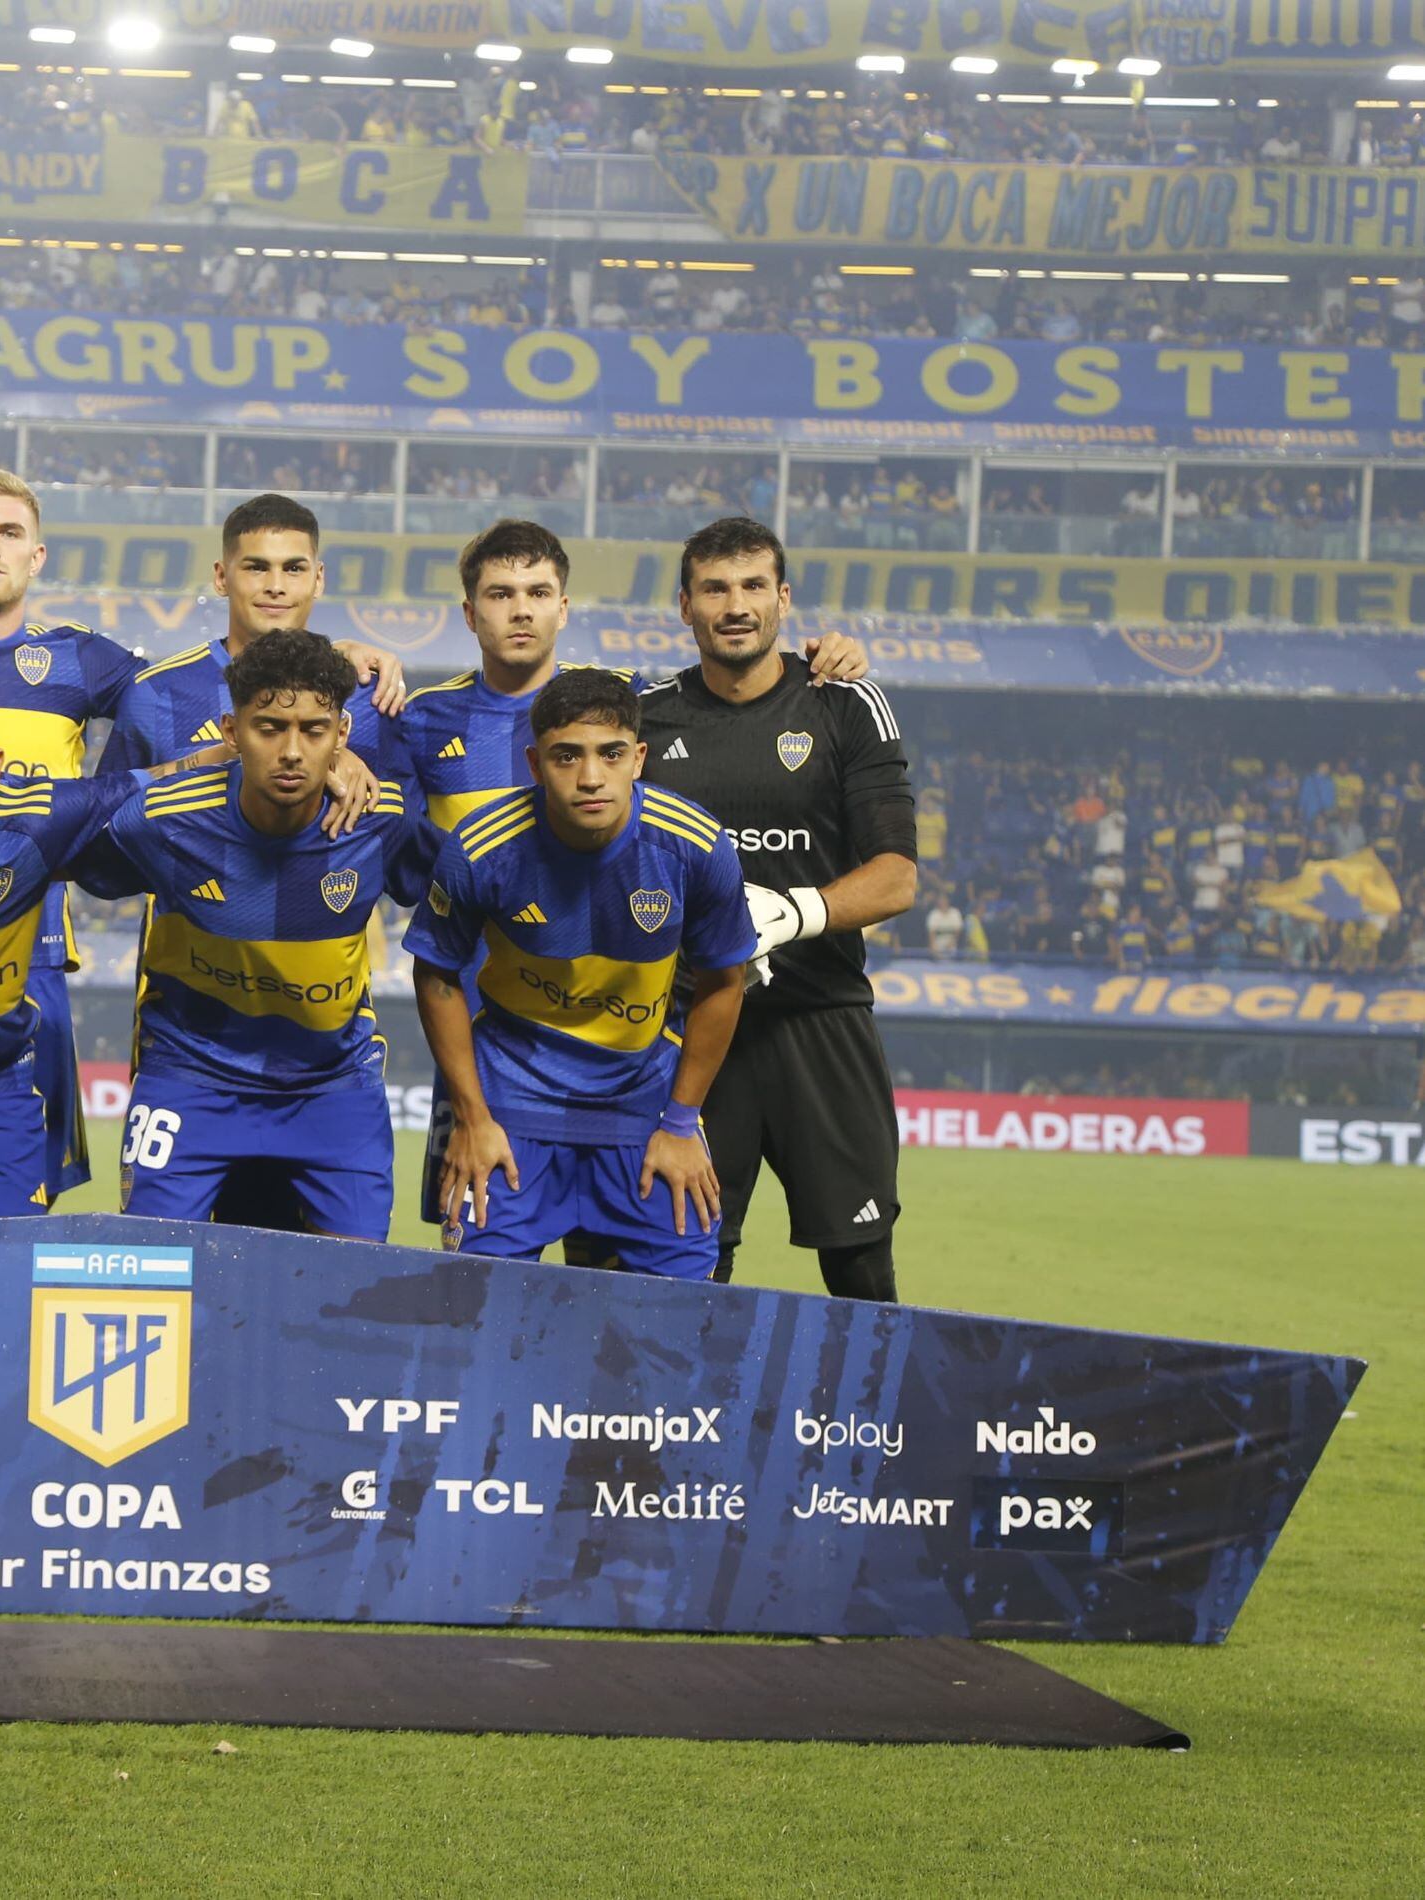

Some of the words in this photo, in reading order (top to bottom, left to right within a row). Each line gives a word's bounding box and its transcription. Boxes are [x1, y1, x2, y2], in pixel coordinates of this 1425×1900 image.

[161, 146, 491, 222] BOCA
[793, 159, 869, 236] UN
[884, 165, 1027, 246] BOCA
[1046, 172, 1239, 252] MEJOR
[403, 330, 711, 405] SOY
[19, 658, 47, 668] CABJ
[781, 744, 808, 752] CABJ
[325, 881, 352, 895] CABJ
[635, 903, 665, 912] CABJ
[190, 947, 352, 1003] betsson
[520, 967, 668, 1023] betsson
[1092, 975, 1425, 1023] flecha
[122, 1104, 181, 1169] 36
[897, 1108, 1205, 1155] HELADERAS
[87, 1253, 138, 1275] AFA
[335, 1398, 460, 1434] YPF
[976, 1407, 1097, 1456] Naldo
[31, 1482, 182, 1530] COPA
[330, 1510, 387, 1520] GATORADE
[435, 1480, 544, 1515] TCL
[591, 1481, 746, 1521] Medifé
[793, 1483, 955, 1527] JetSMART
[999, 1495, 1093, 1536] pax
[42, 1548, 272, 1594] Finanzas
